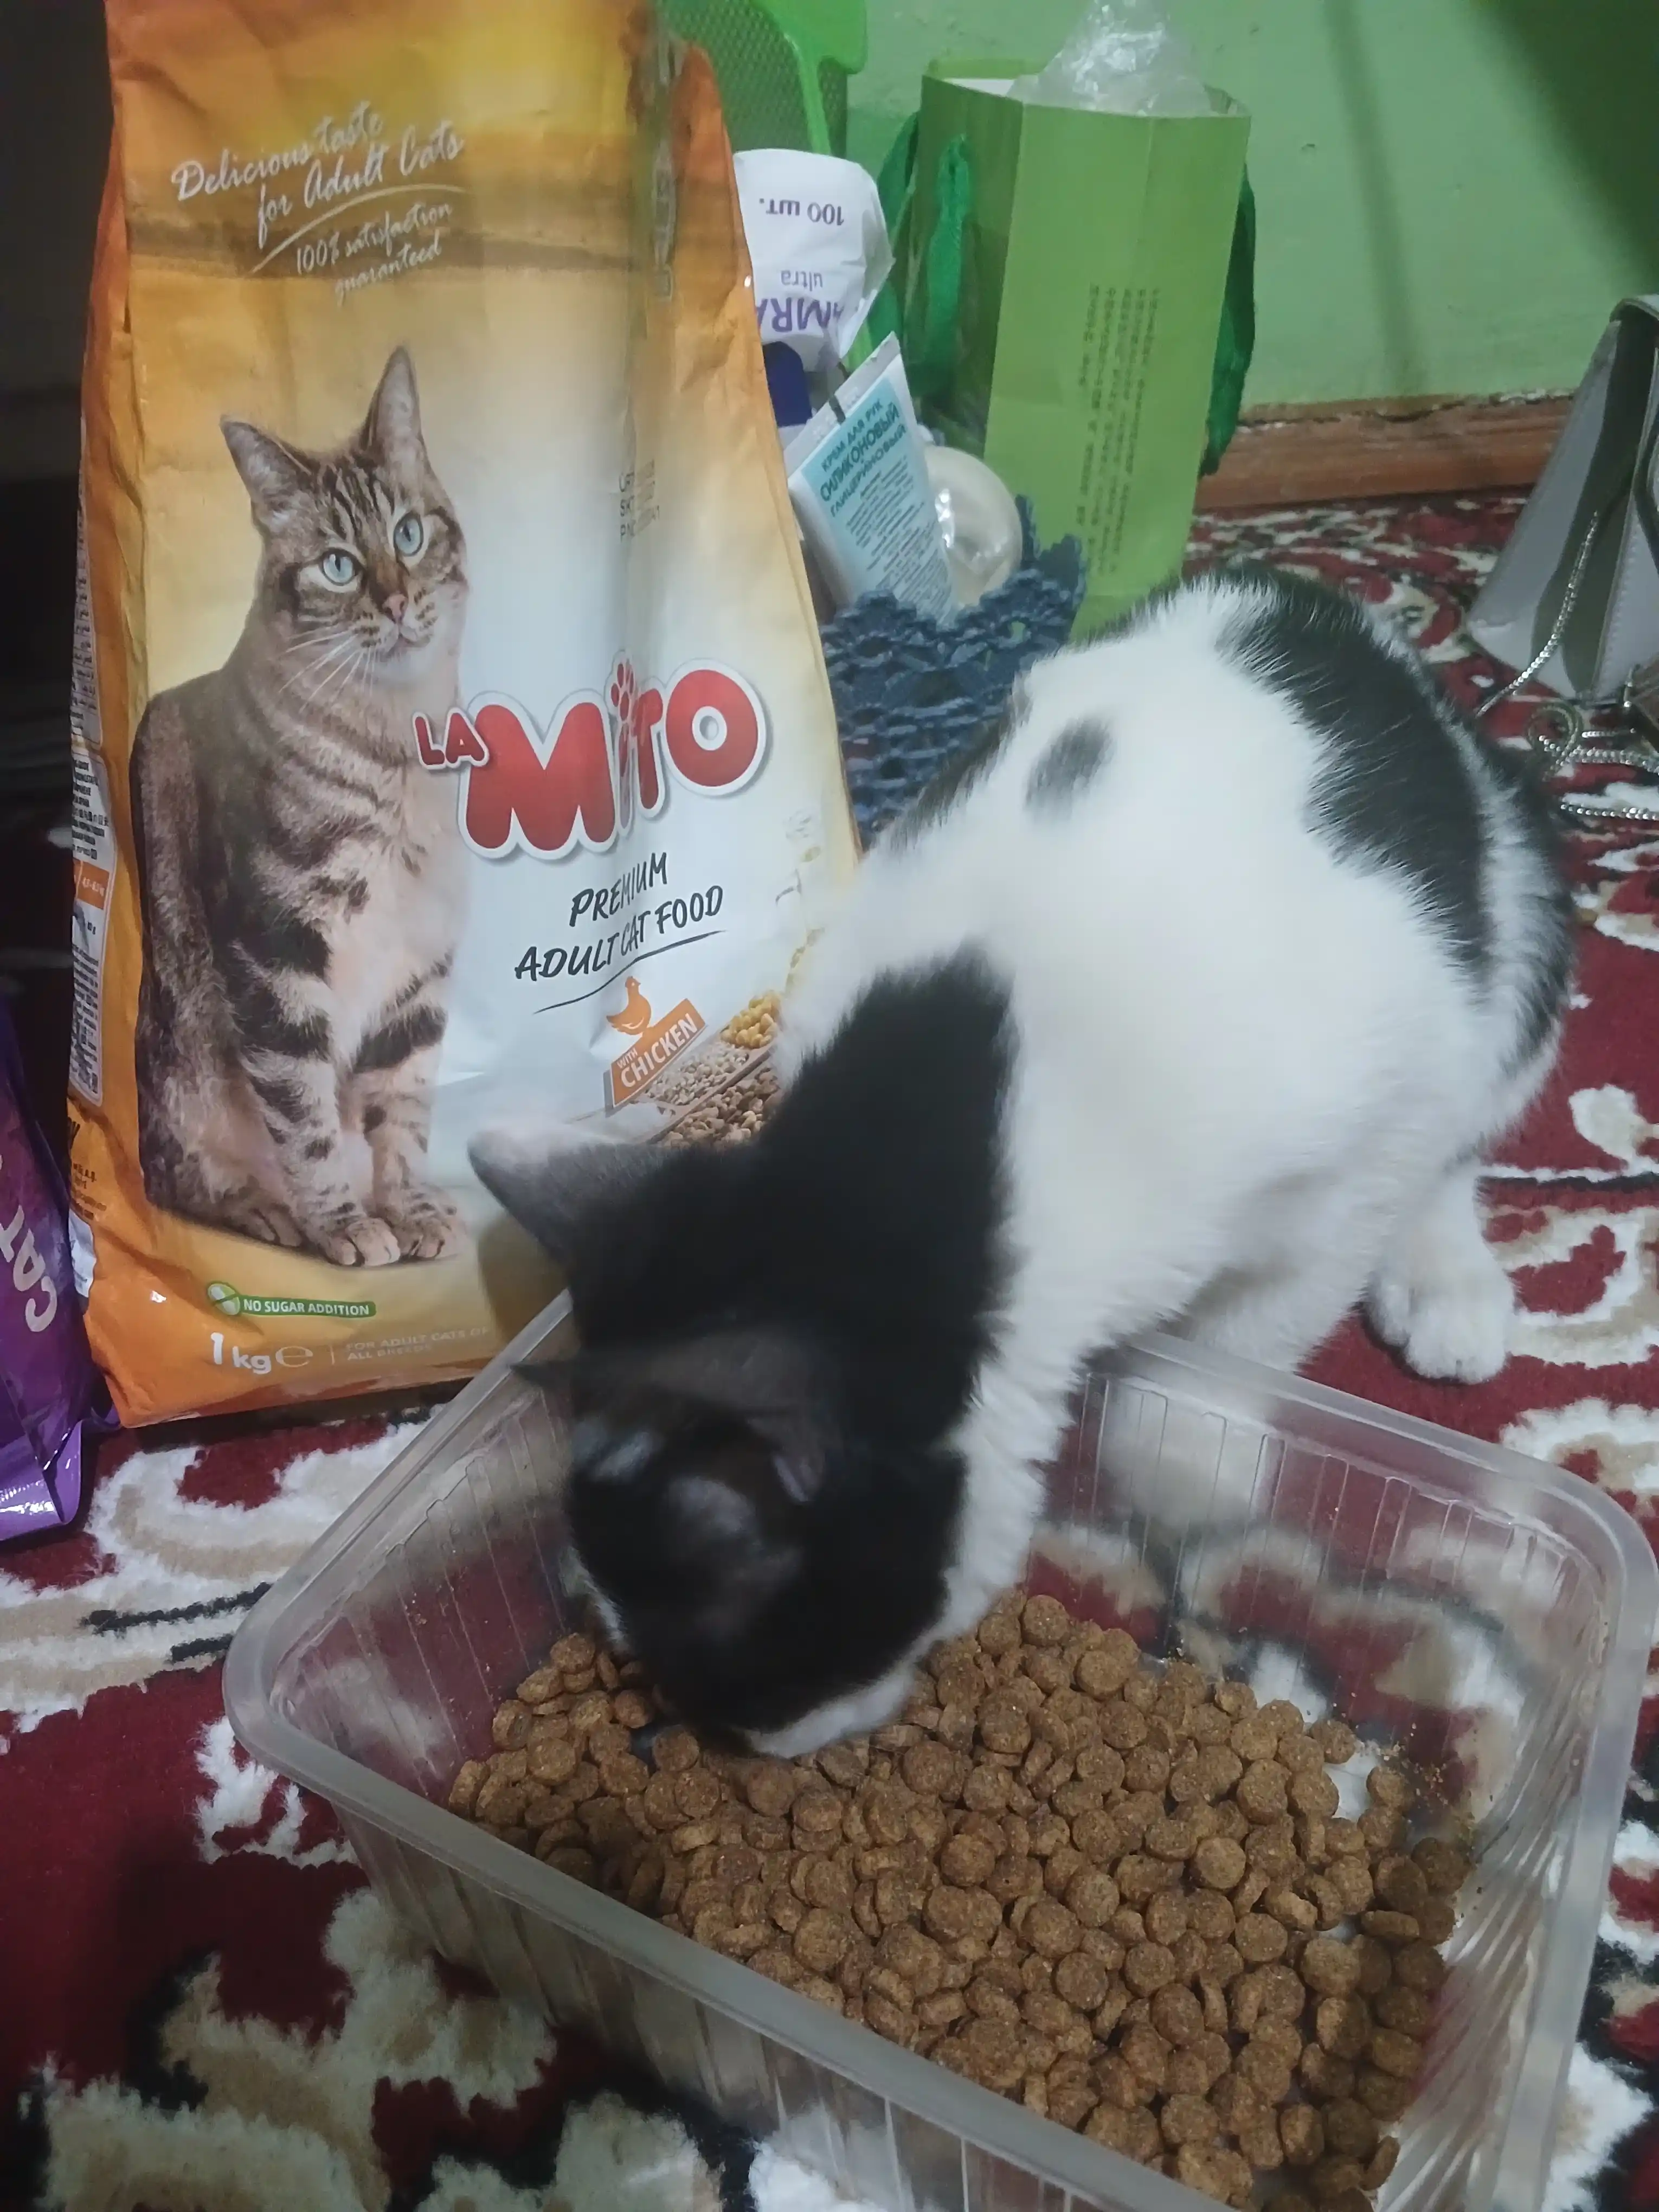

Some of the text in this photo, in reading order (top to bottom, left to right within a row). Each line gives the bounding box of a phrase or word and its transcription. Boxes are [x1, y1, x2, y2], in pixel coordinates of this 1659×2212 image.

[171, 101, 382, 202] Delicious taste
[256, 119, 465, 249] for Adult Cats
[807, 202, 845, 227] 100
[295, 202, 453, 274] 100% satisfaction
[334, 228, 442, 307] guaranteed
[781, 269, 823, 292] ultra
[820, 401, 900, 502] СИЛИКОНОВЫЙ
[415, 712, 486, 766] LA
[569, 852, 668, 927] PREMIUM
[515, 885, 724, 981] ADULT CAT FOOD
[617, 1049, 638, 1069] WITH
[620, 1013, 698, 1088] CHICKEN
[243, 1298, 370, 1316] NO SUGAR ADDITION
[233, 1346, 272, 1374] kg
[347, 1348, 373, 1361] ALL
[381, 1334, 427, 1348] ADULT
[430, 1331, 464, 1341] CATS
